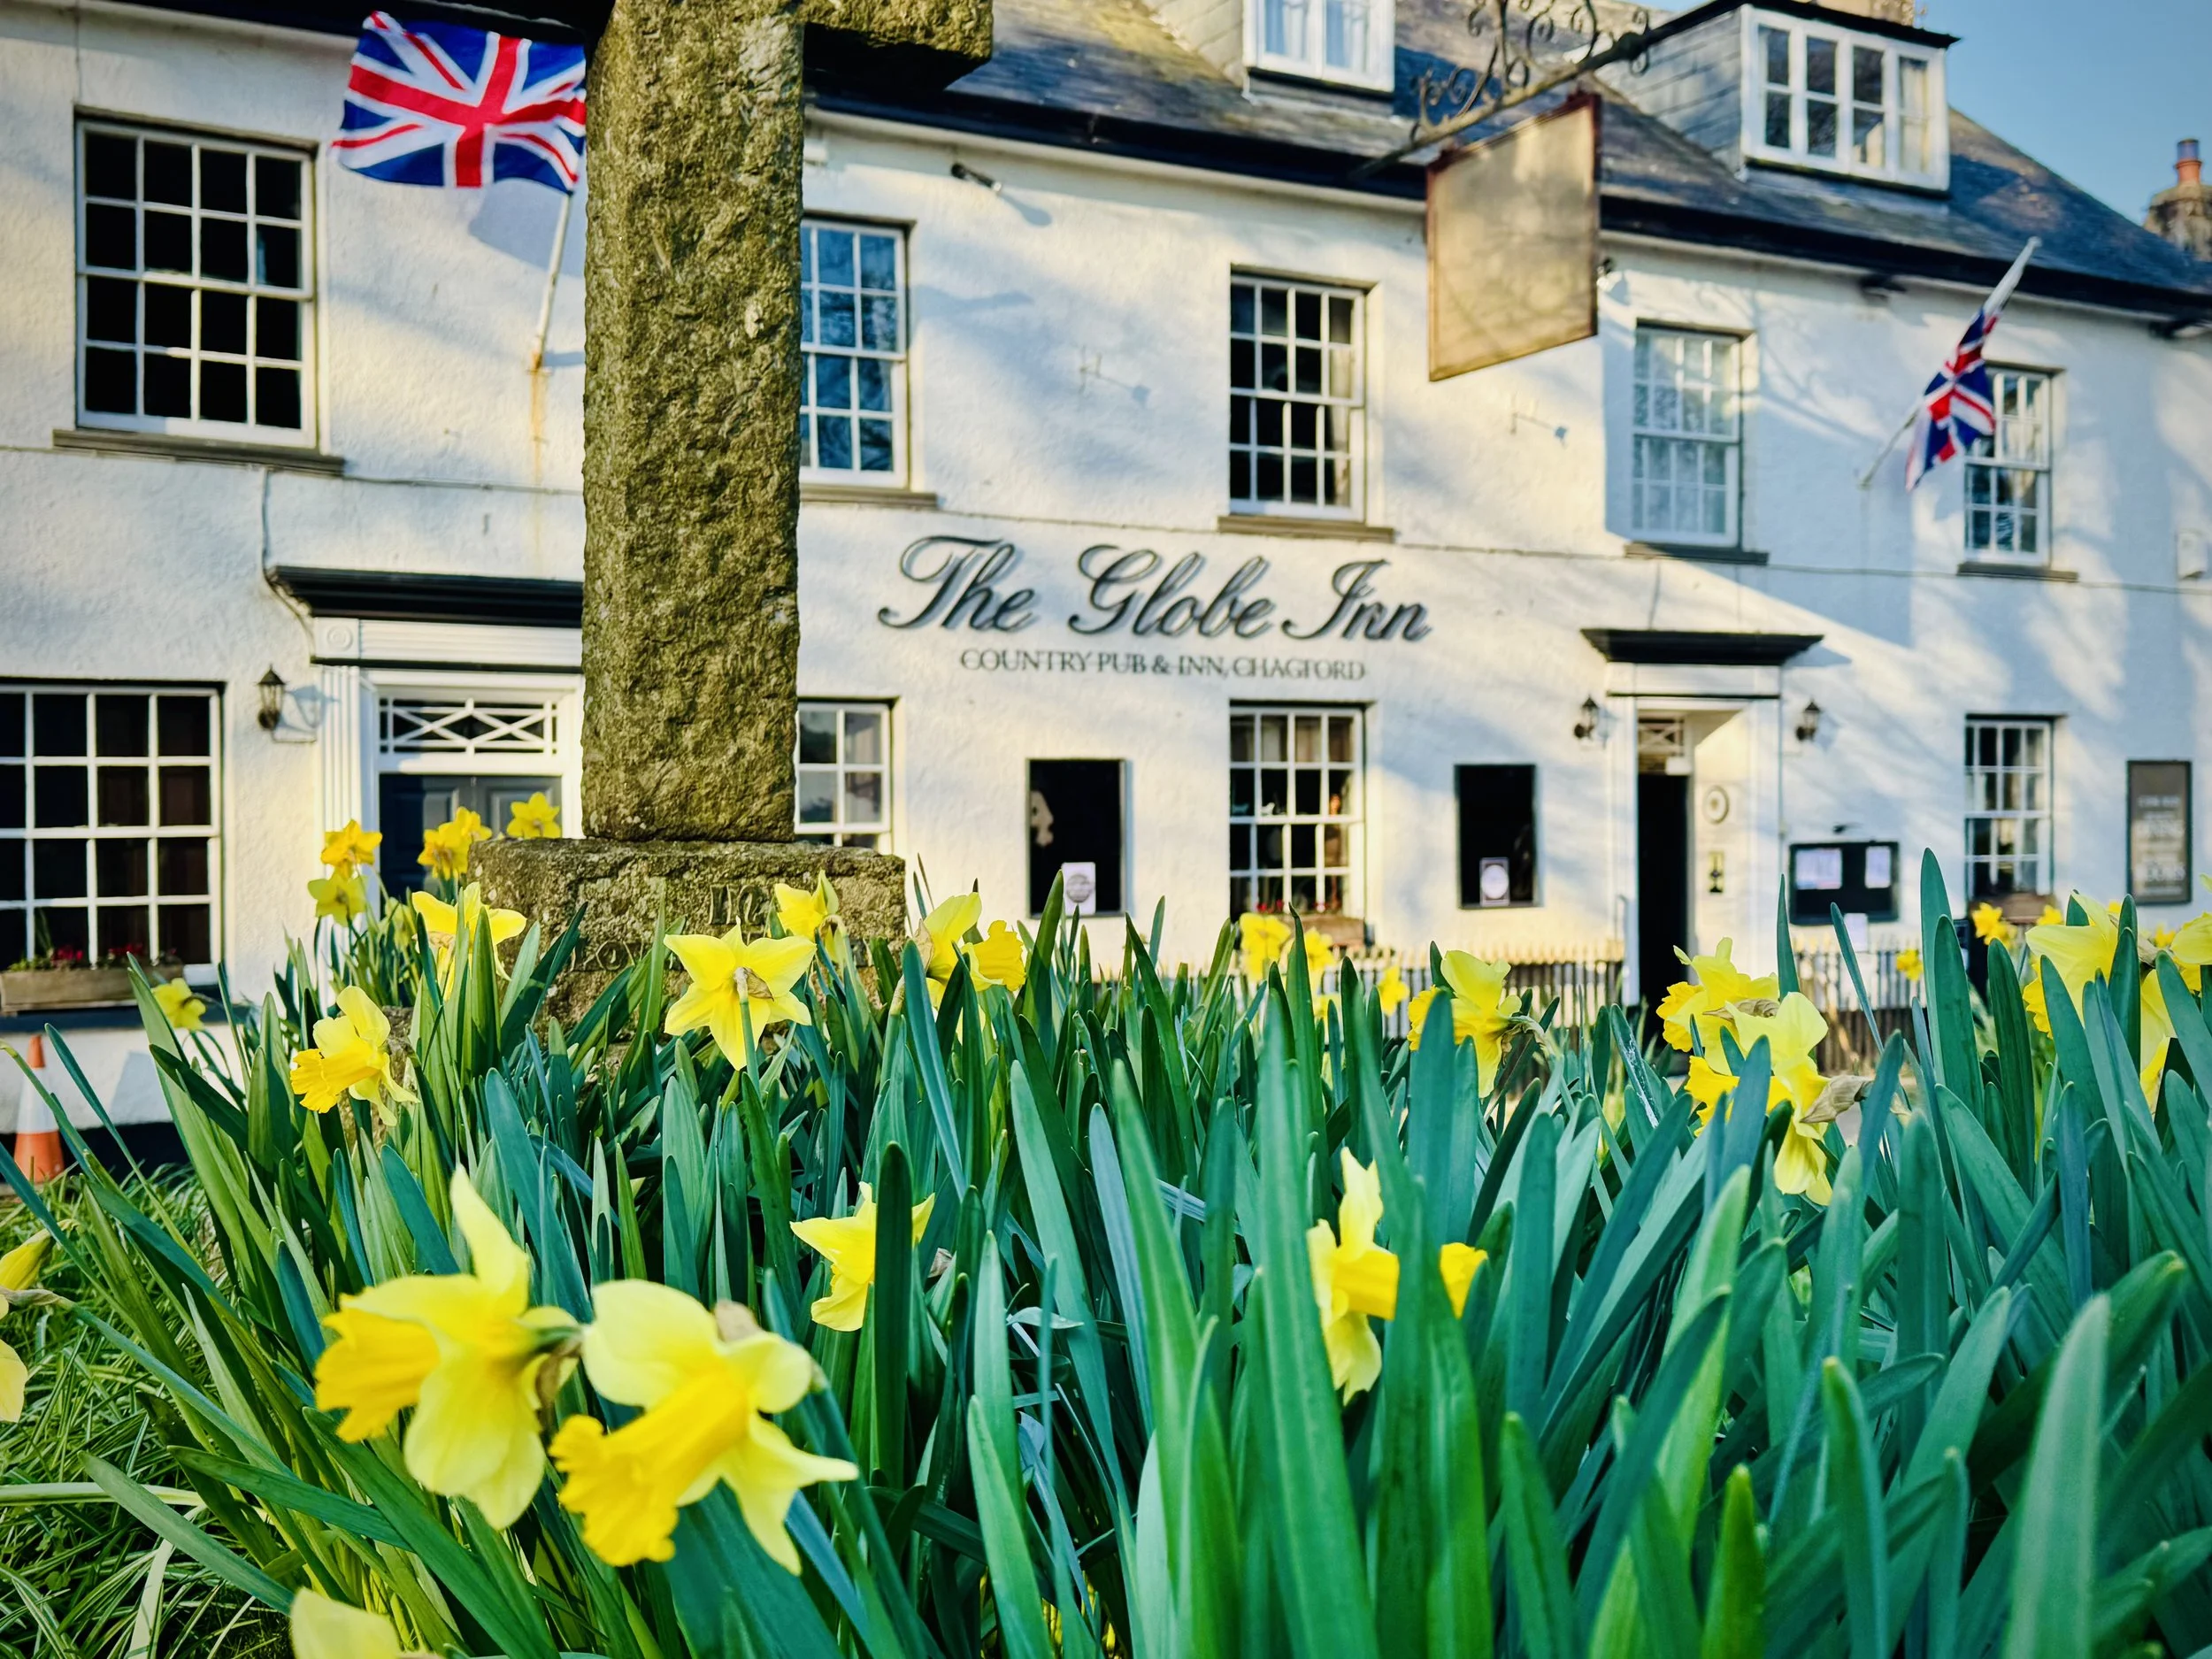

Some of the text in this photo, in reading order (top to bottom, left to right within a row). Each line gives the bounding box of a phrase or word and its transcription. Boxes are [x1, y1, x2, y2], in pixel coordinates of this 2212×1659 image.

[877, 535, 1432, 642] The Globe Inn
[960, 648, 1092, 672] COUNTRY
[1096, 651, 1148, 675] PUB
[1151, 653, 1172, 675] &
